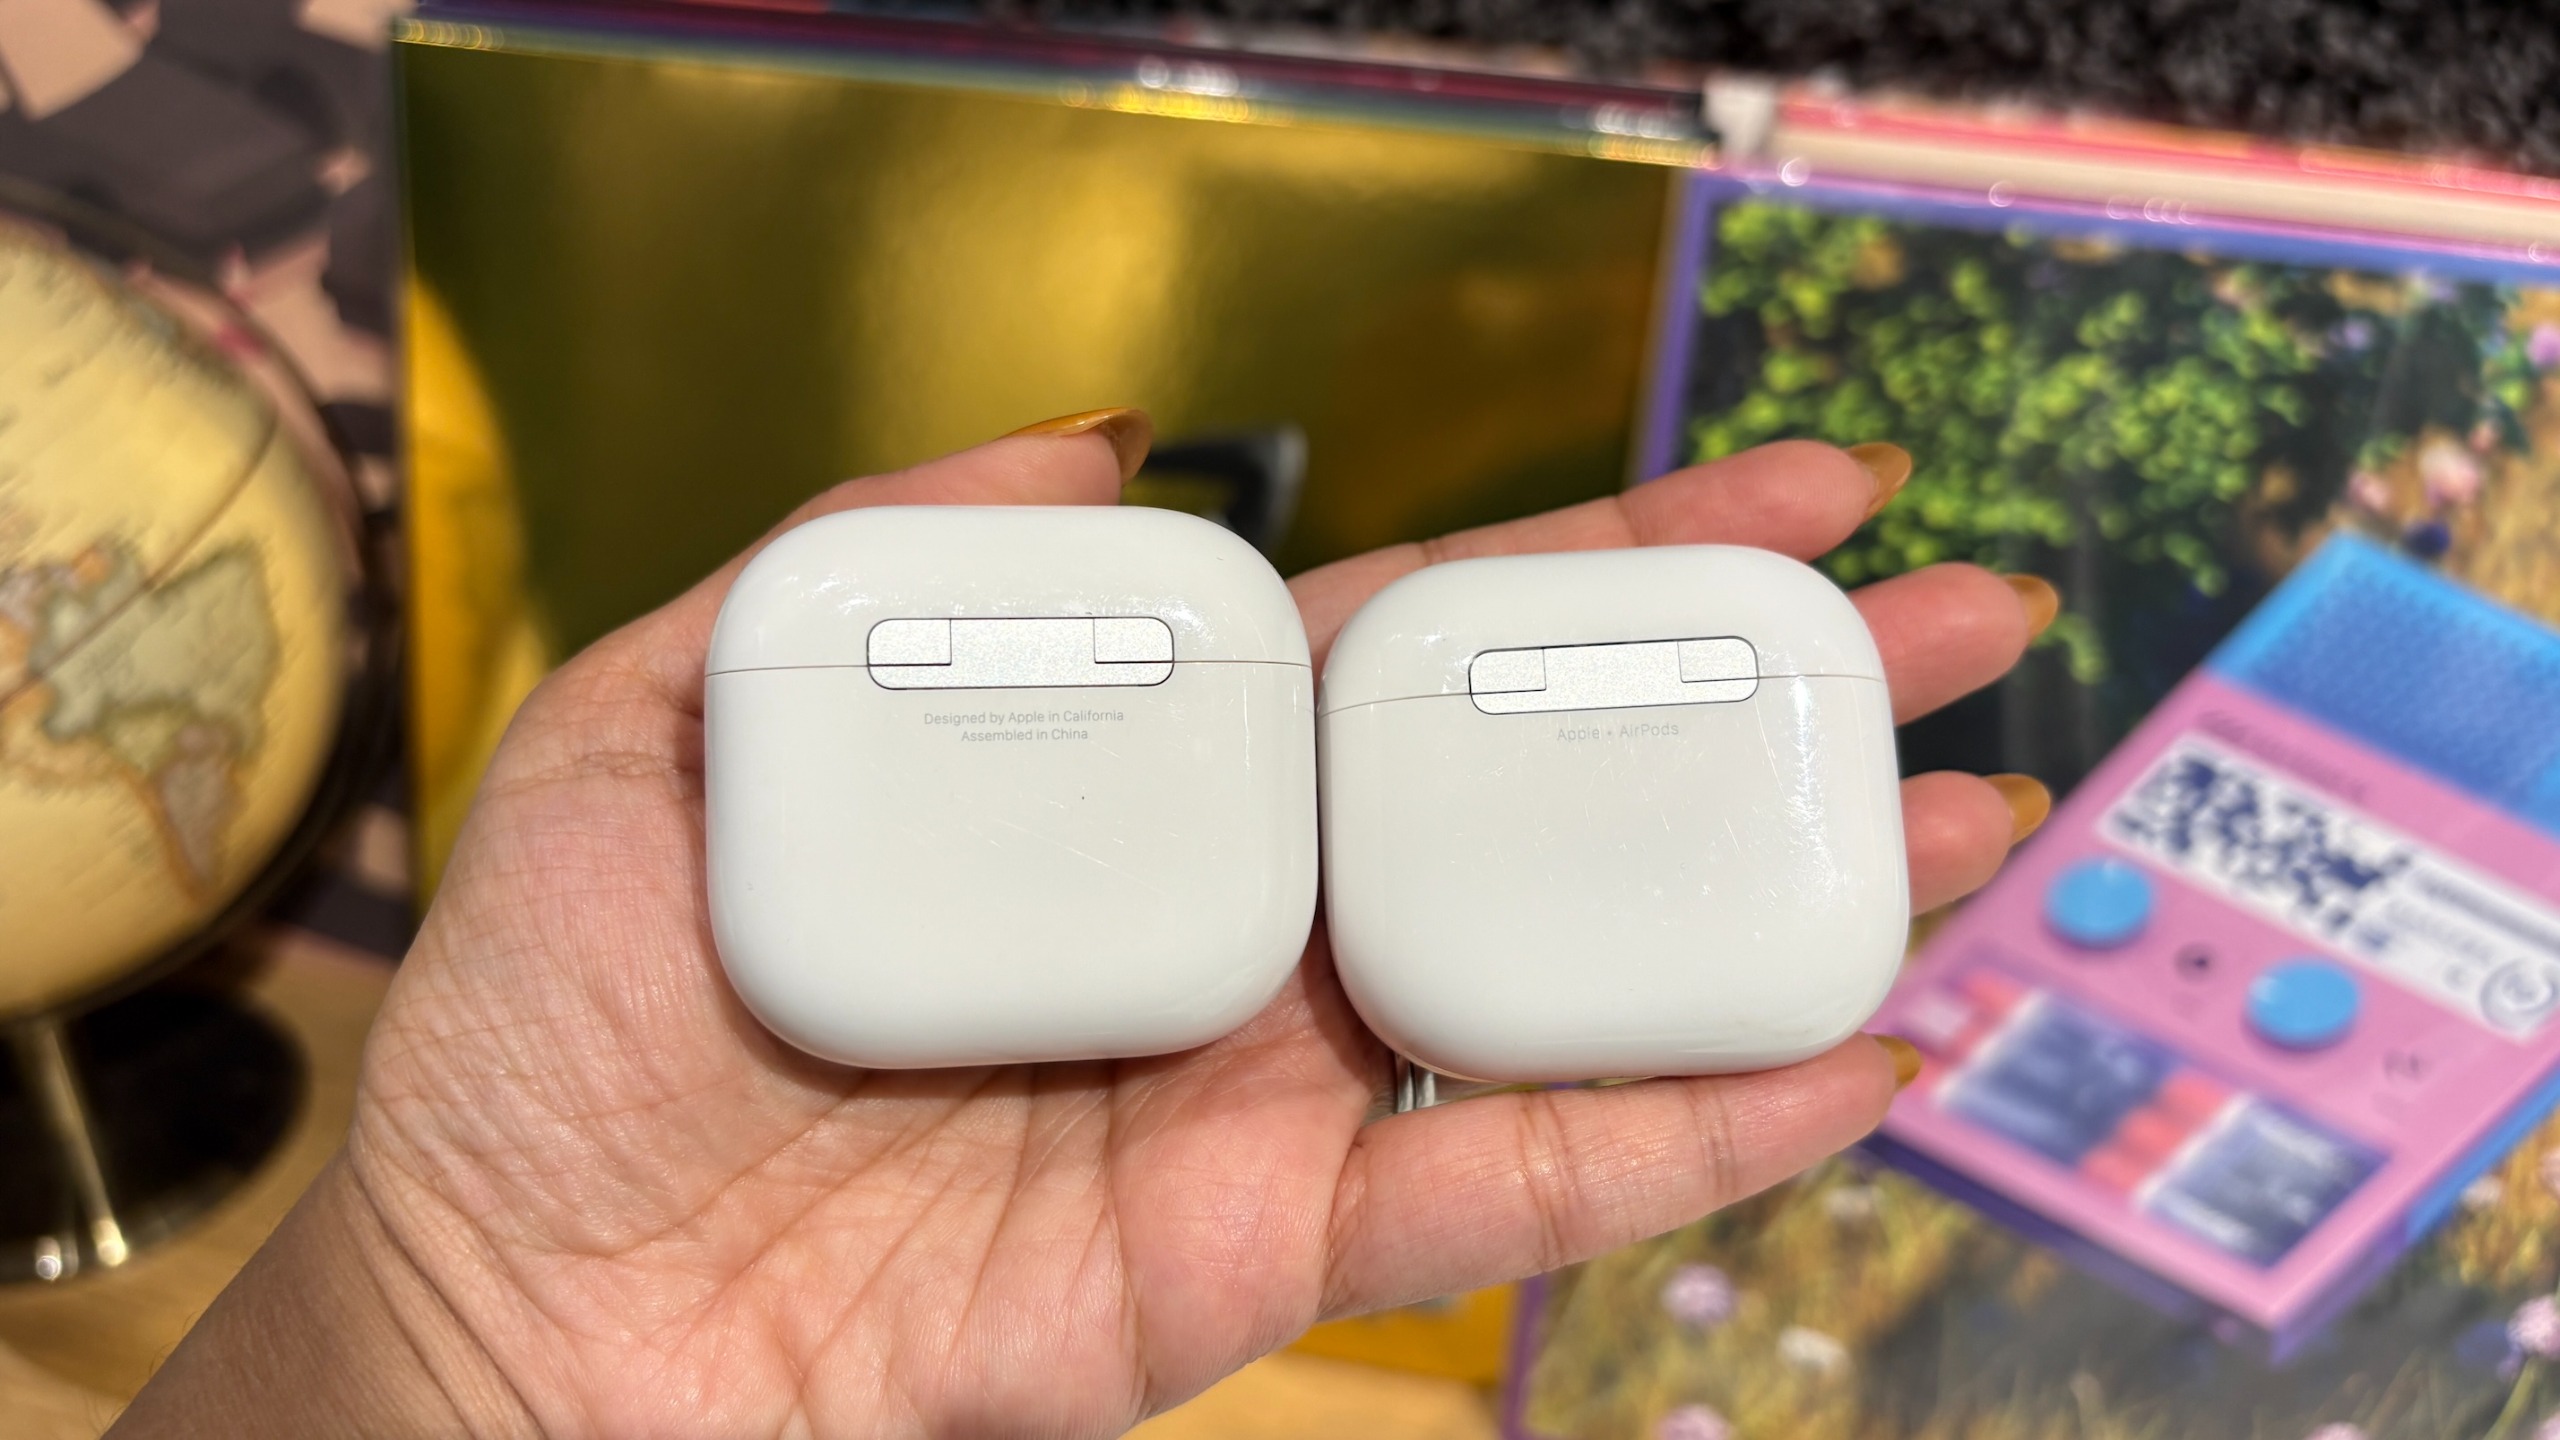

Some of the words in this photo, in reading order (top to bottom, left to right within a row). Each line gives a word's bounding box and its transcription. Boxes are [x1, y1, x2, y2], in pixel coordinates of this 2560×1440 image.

[924, 712, 986, 726] Designed
[989, 711, 1004, 725] by
[1008, 711, 1045, 725] Apple
[1048, 710, 1060, 722] in
[1063, 709, 1124, 722] California
[961, 729, 1033, 742] Assembled
[1036, 729, 1048, 740] in
[1051, 728, 1089, 740] China
[1557, 726, 1600, 742] Apple
[1619, 722, 1680, 738] AirPods
